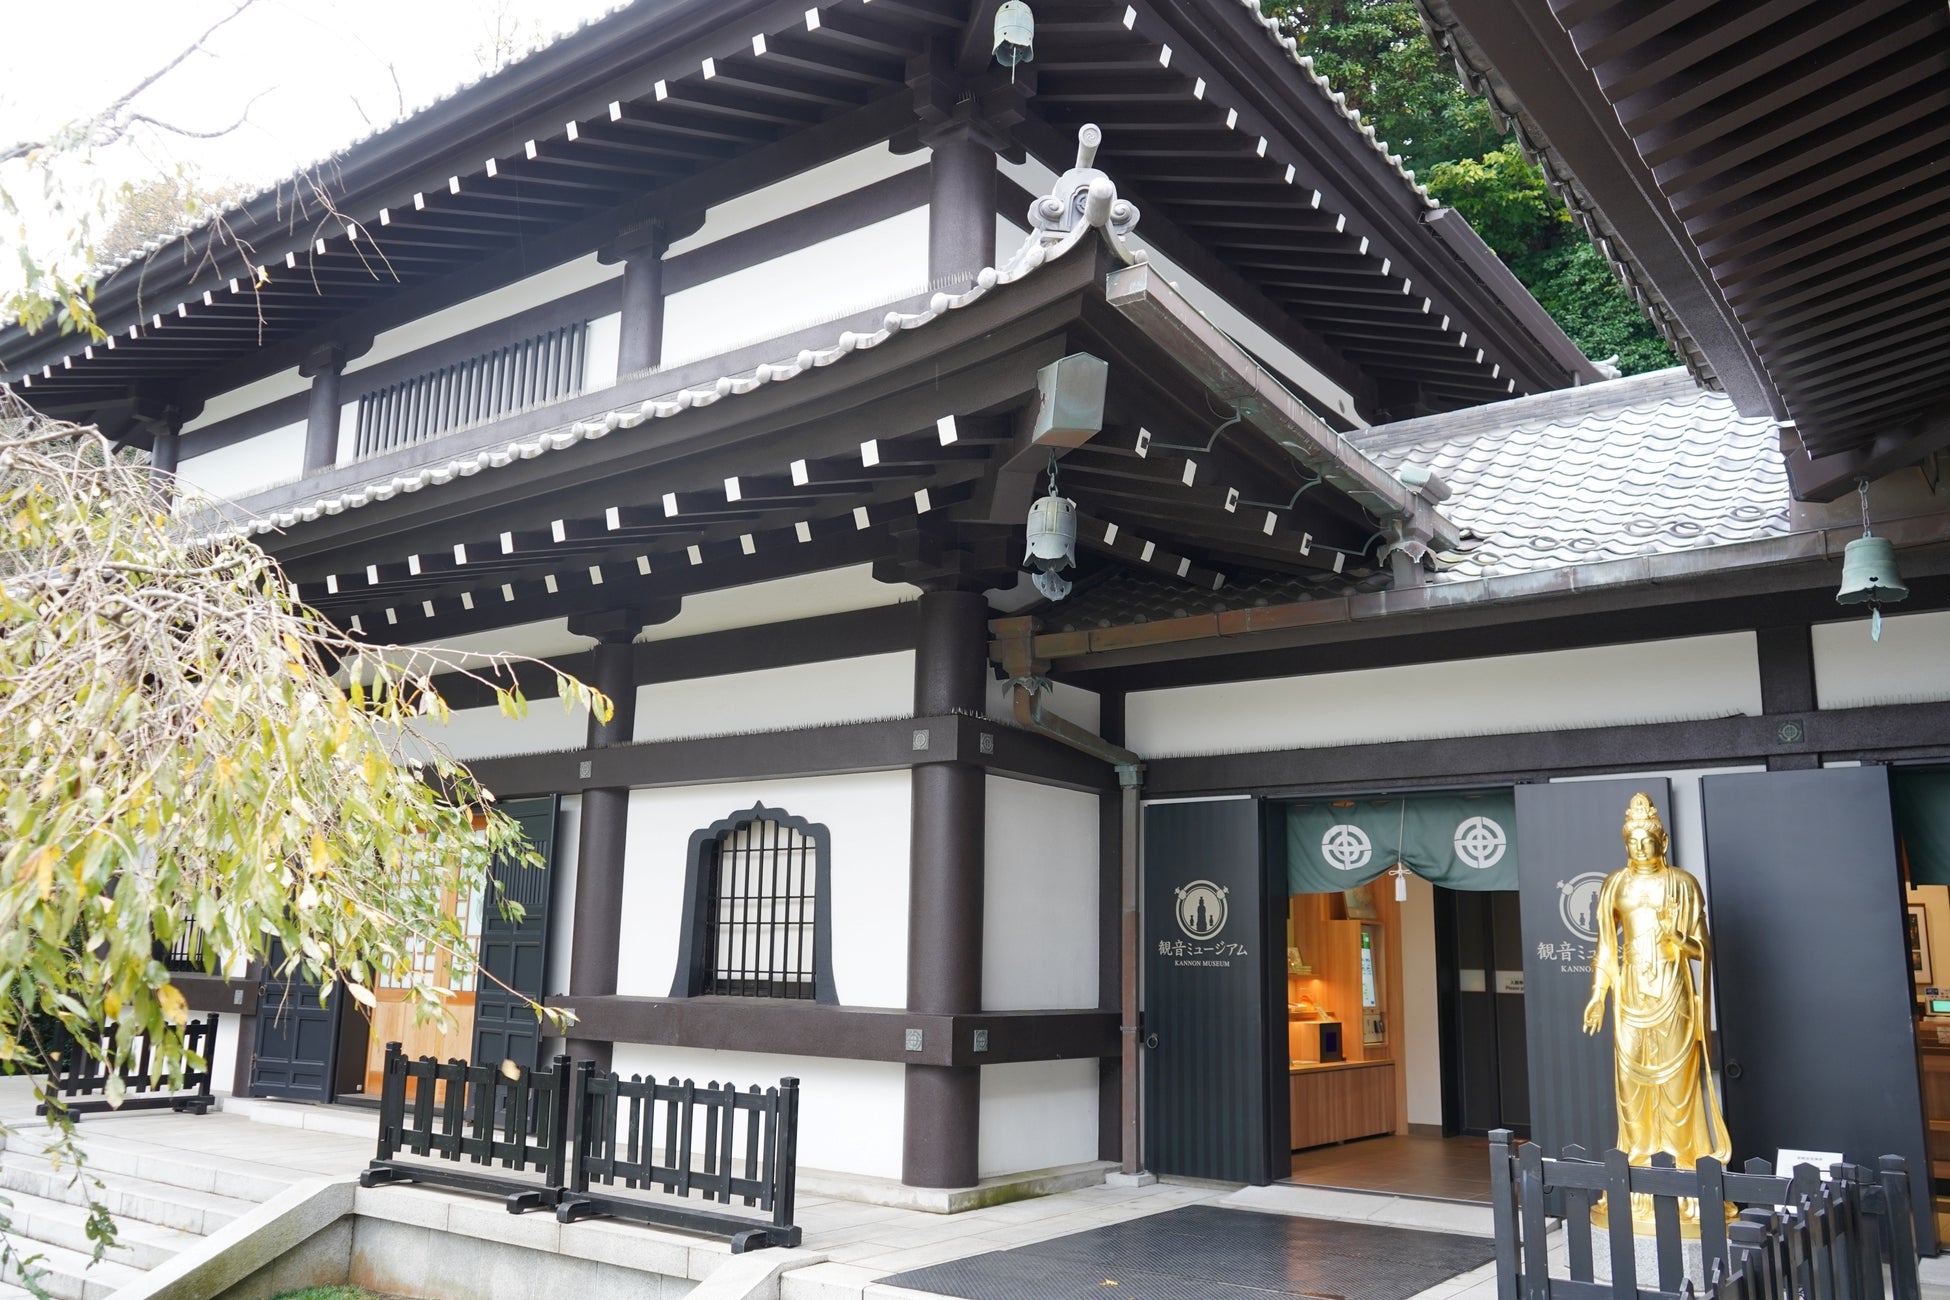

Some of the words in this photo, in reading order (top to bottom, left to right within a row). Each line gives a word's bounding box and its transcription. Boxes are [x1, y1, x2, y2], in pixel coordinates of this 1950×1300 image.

[1158, 939, 1248, 957] 観音ミュージアム
[1561, 965, 1594, 973] KANNO
